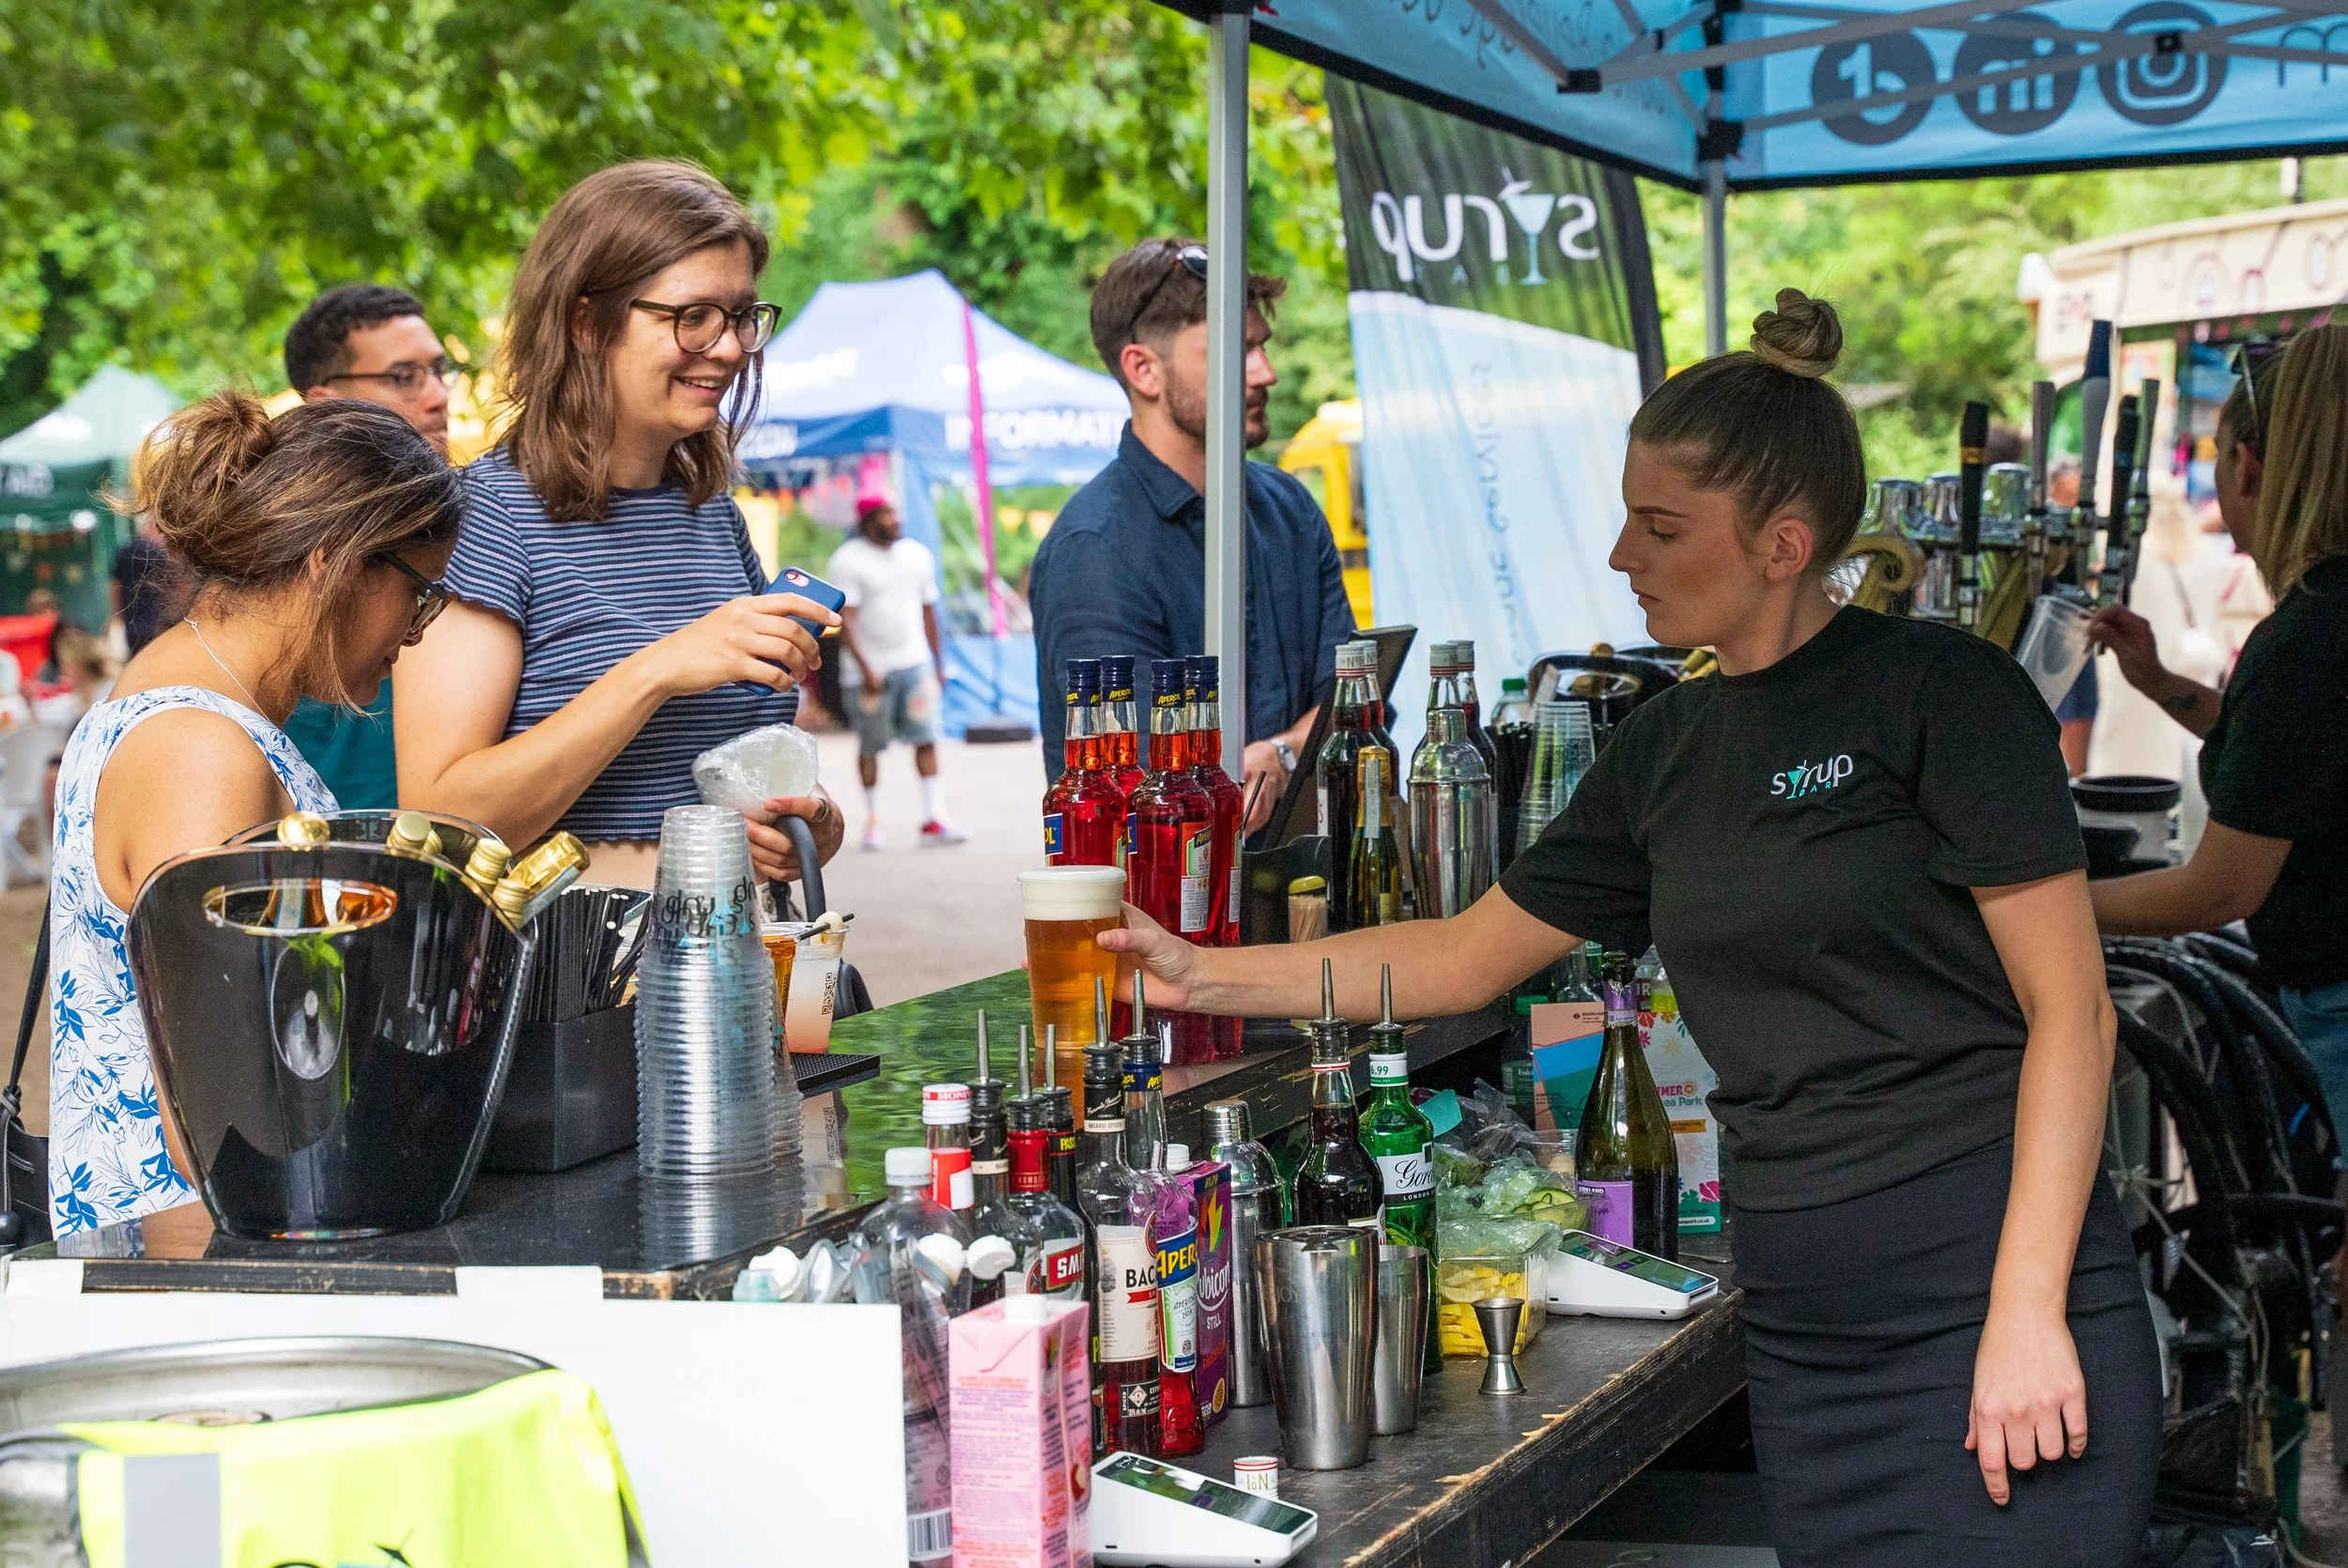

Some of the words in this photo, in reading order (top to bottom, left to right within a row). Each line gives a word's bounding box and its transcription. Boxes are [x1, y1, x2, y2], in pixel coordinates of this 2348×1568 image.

[1109, 687, 1132, 699] APEROL
[1158, 693, 1181, 704] APEROL
[1770, 755, 1853, 799] syrup
[1800, 781, 1831, 796] BAR
[1678, 1097, 1703, 1106] Park
[1207, 1314, 1222, 1330] STILL
